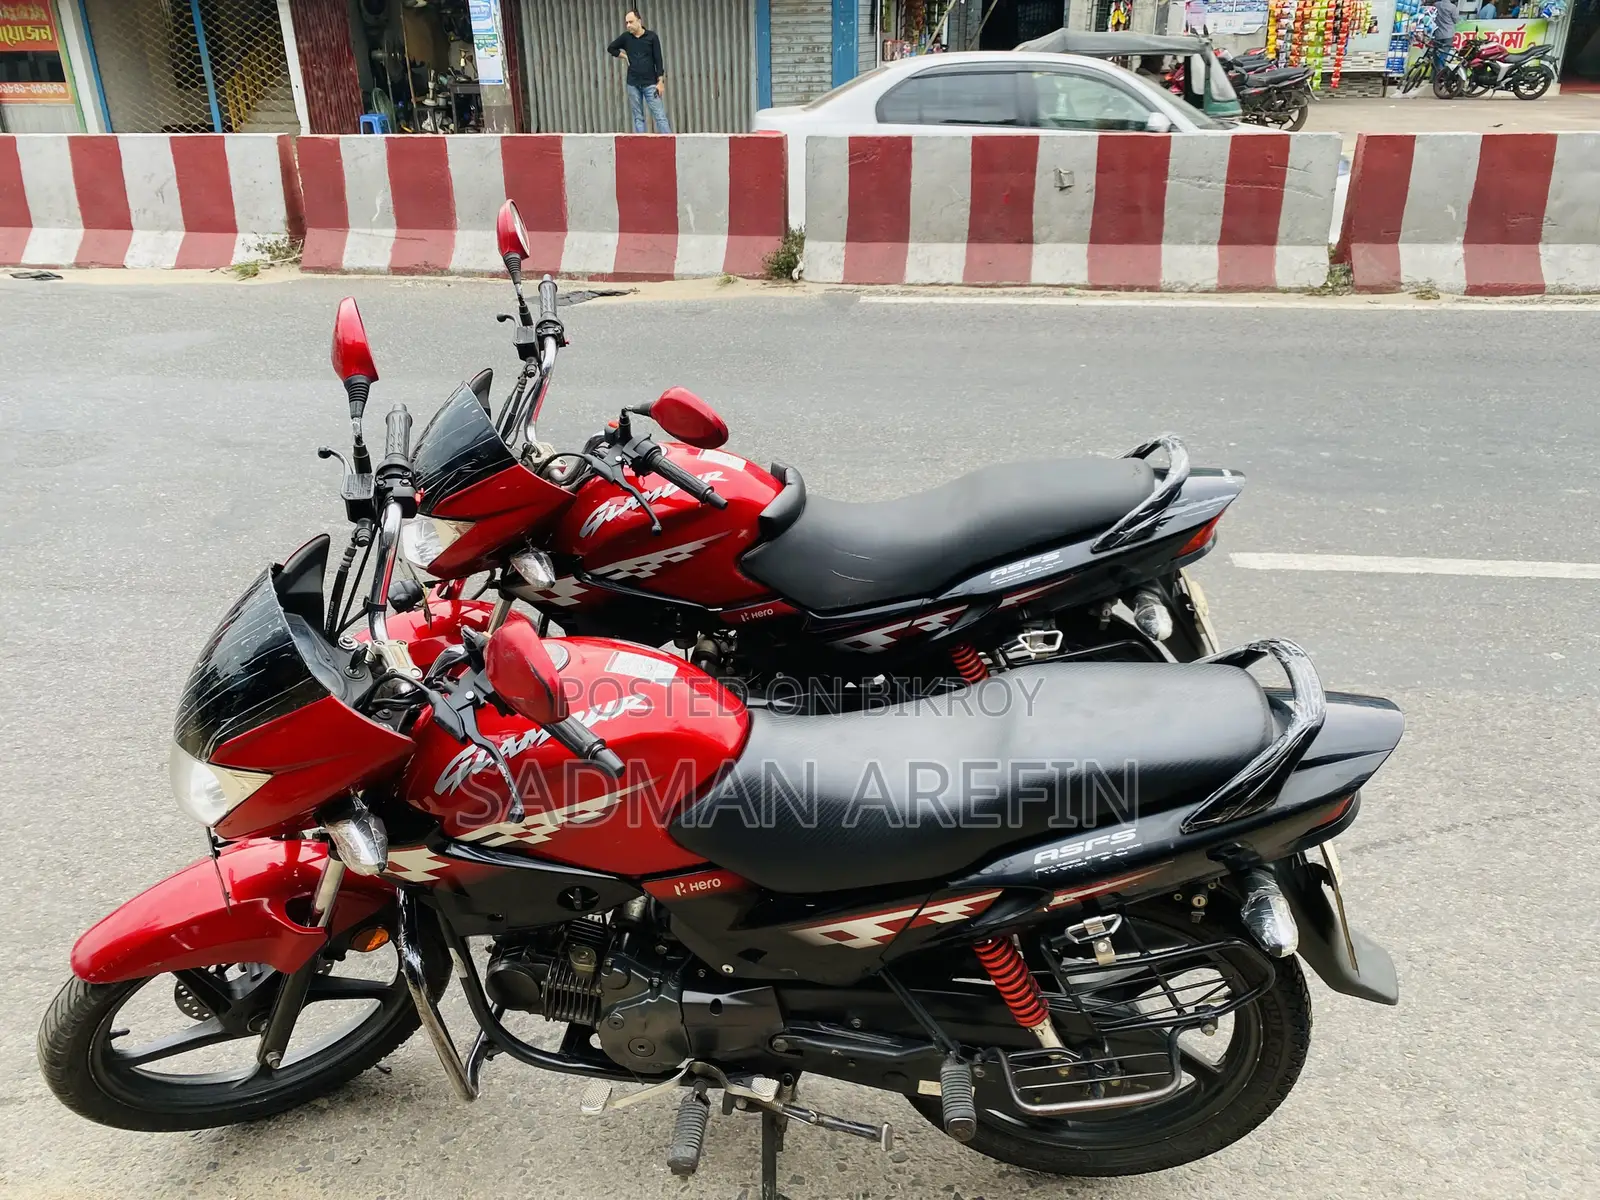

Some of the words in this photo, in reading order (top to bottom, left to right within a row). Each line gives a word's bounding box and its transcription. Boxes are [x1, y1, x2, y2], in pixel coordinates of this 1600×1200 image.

[0, 25, 52, 47] য়োজন
[1034, 828, 1137, 864] ASFS
[689, 878, 721, 892] Hero
